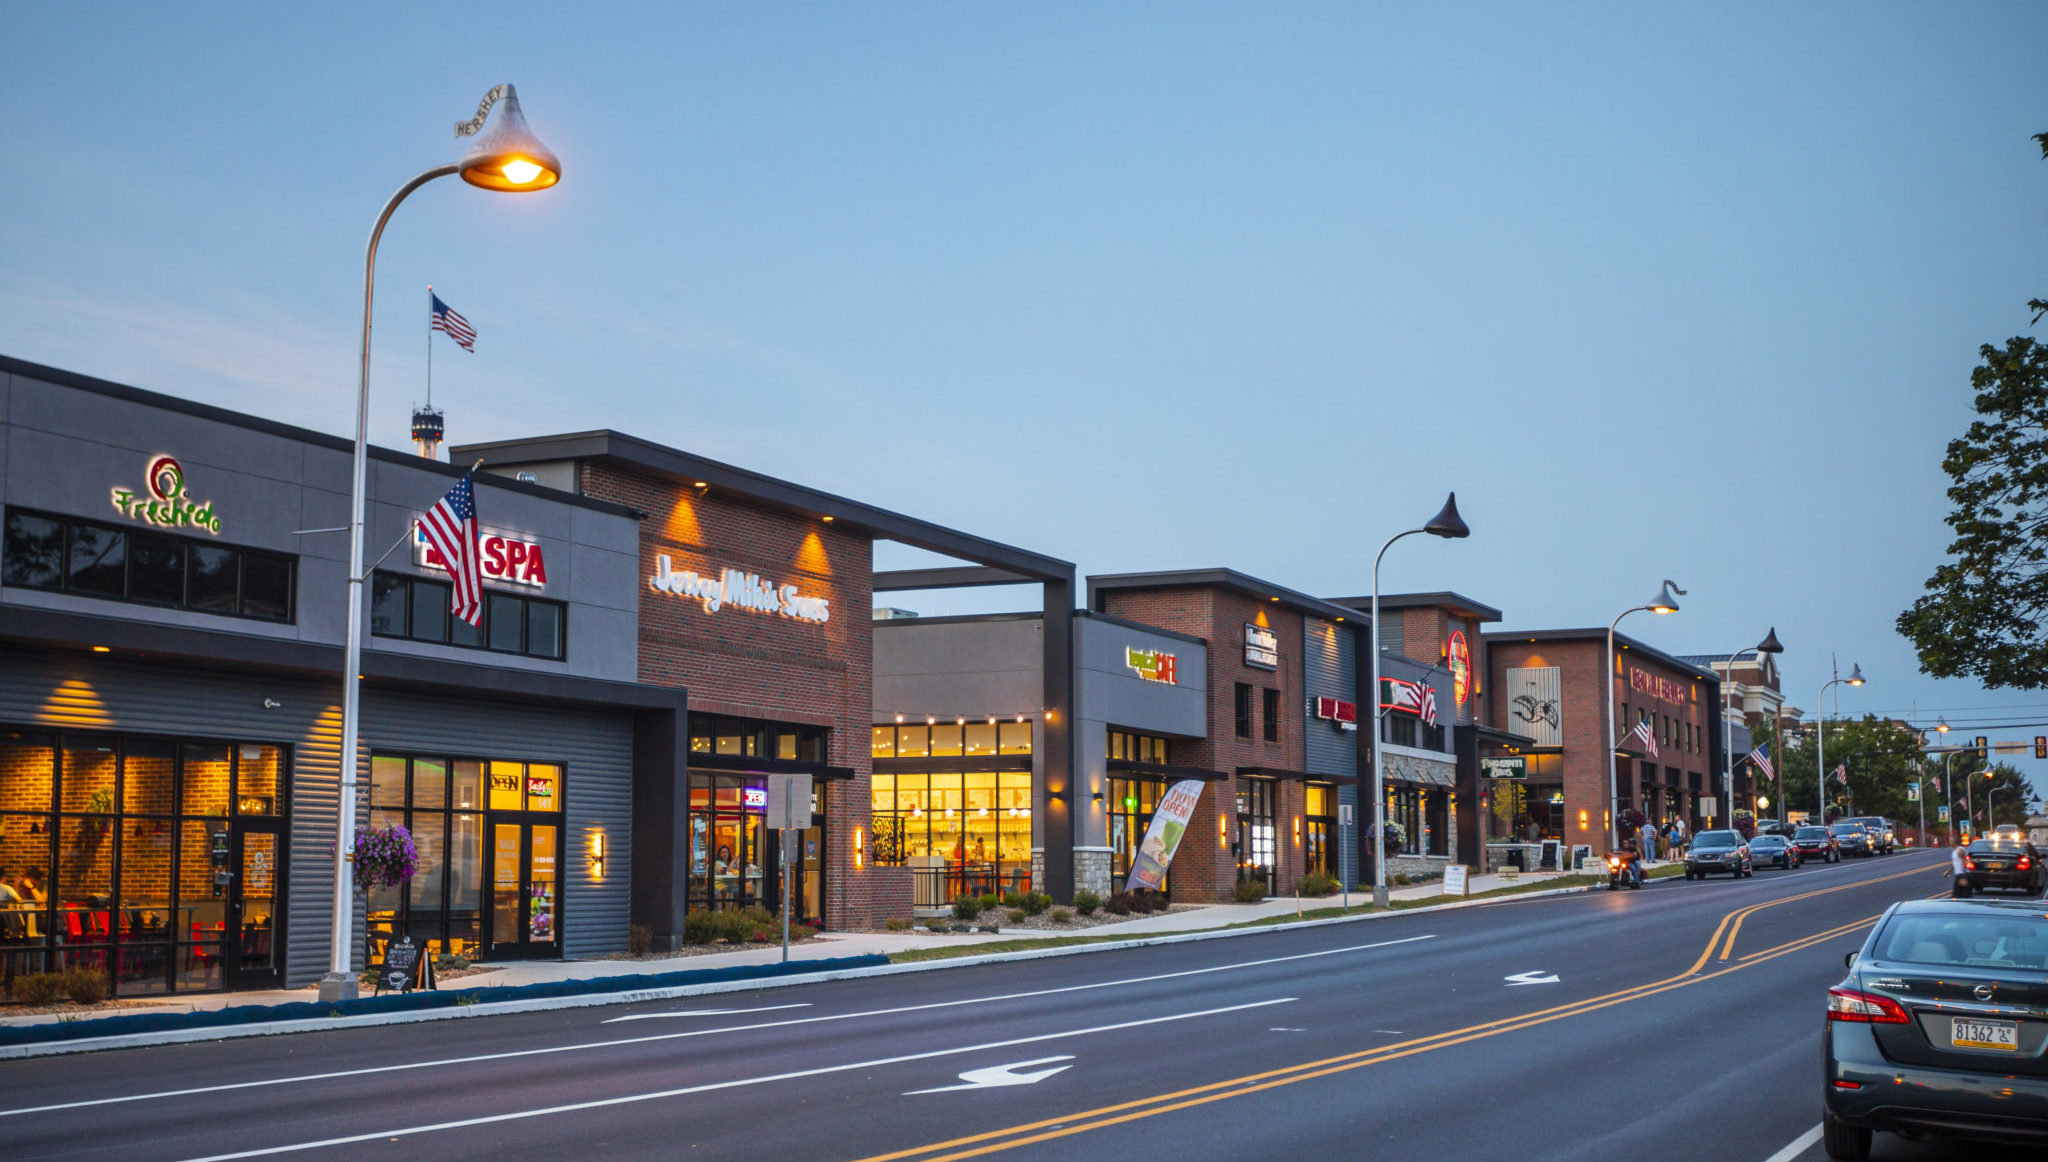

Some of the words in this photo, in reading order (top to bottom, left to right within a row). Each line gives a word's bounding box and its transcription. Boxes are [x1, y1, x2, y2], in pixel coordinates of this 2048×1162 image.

[456, 86, 502, 136] HERSHEY
[114, 490, 221, 532] Freshido
[484, 536, 547, 584] SPA
[652, 555, 721, 612] Jersey
[538, 798, 552, 809] 141
[1956, 1024, 1993, 1042] 81362
